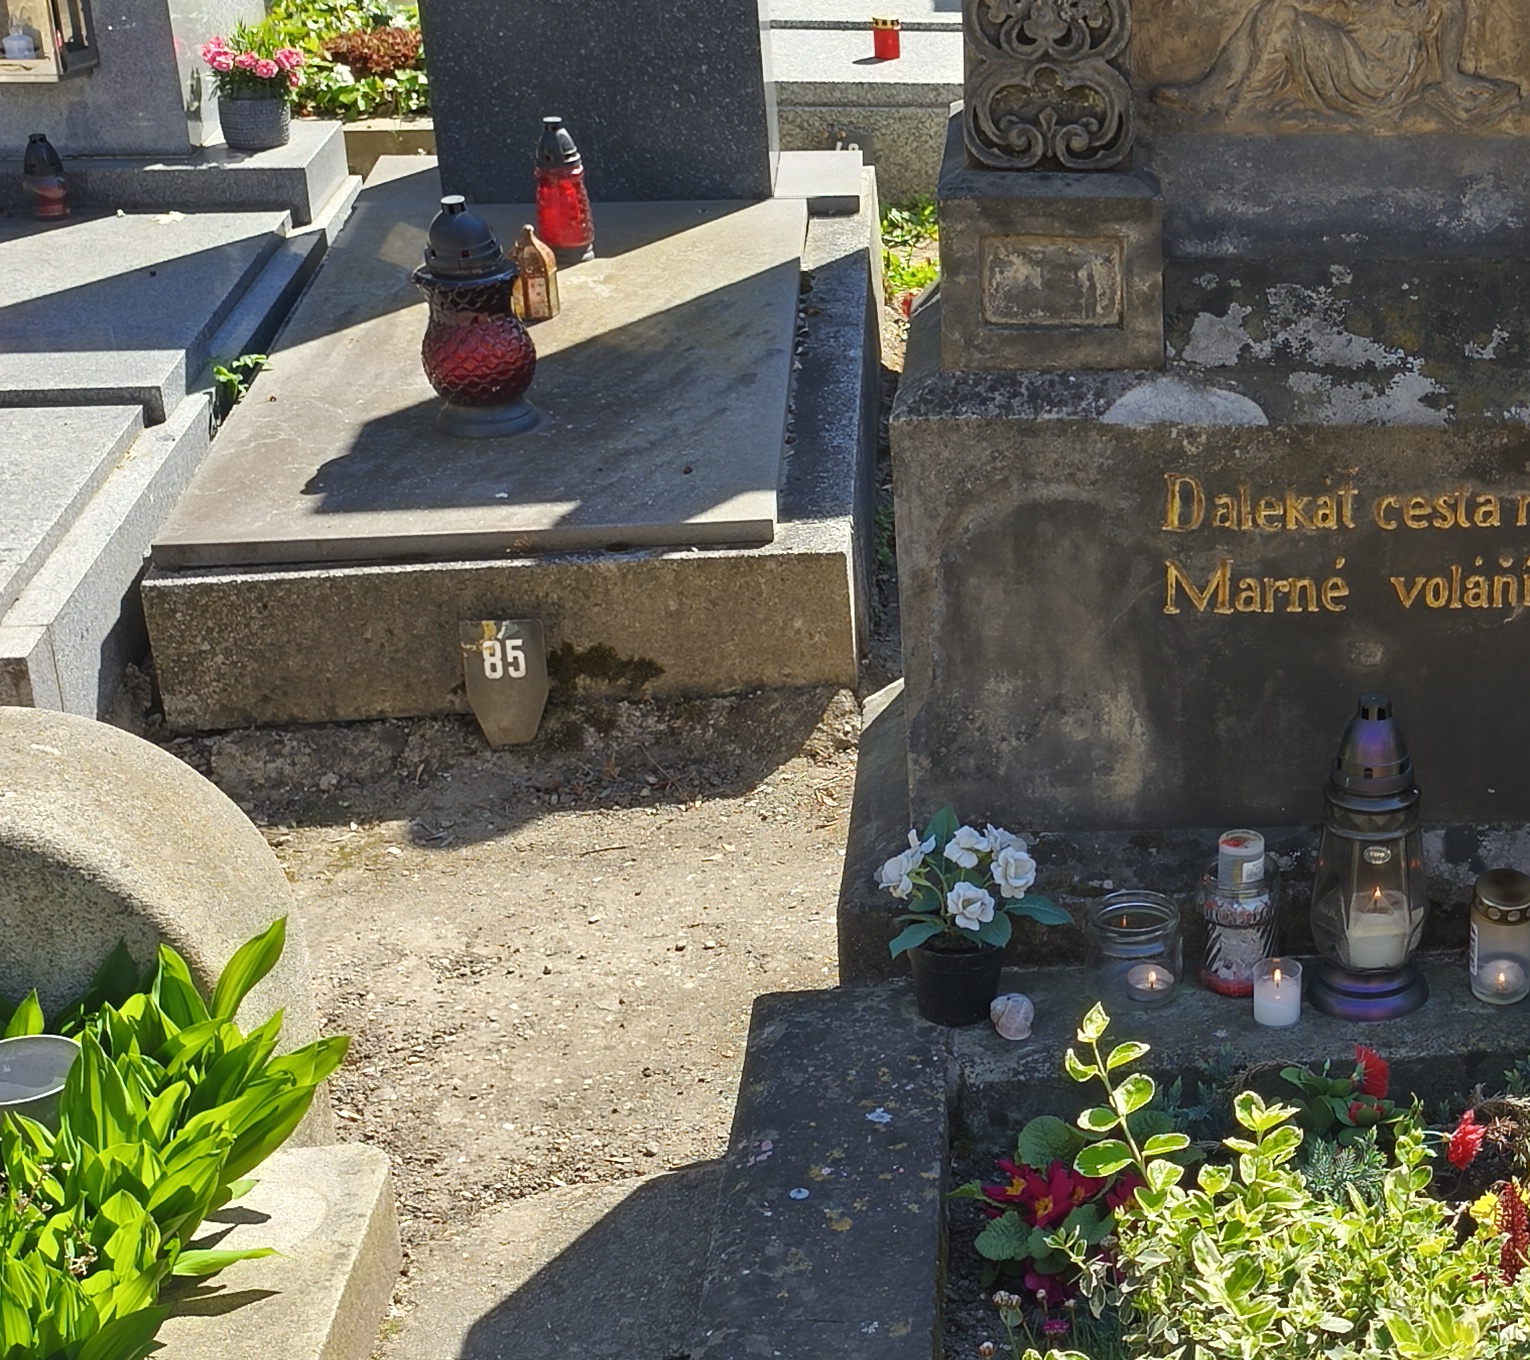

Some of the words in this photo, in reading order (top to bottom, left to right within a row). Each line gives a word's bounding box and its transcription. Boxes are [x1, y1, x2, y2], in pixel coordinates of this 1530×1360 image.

[1374, 484, 1501, 530] cesta
[1163, 556, 1349, 615] Marné
[482, 639, 526, 679] 85
